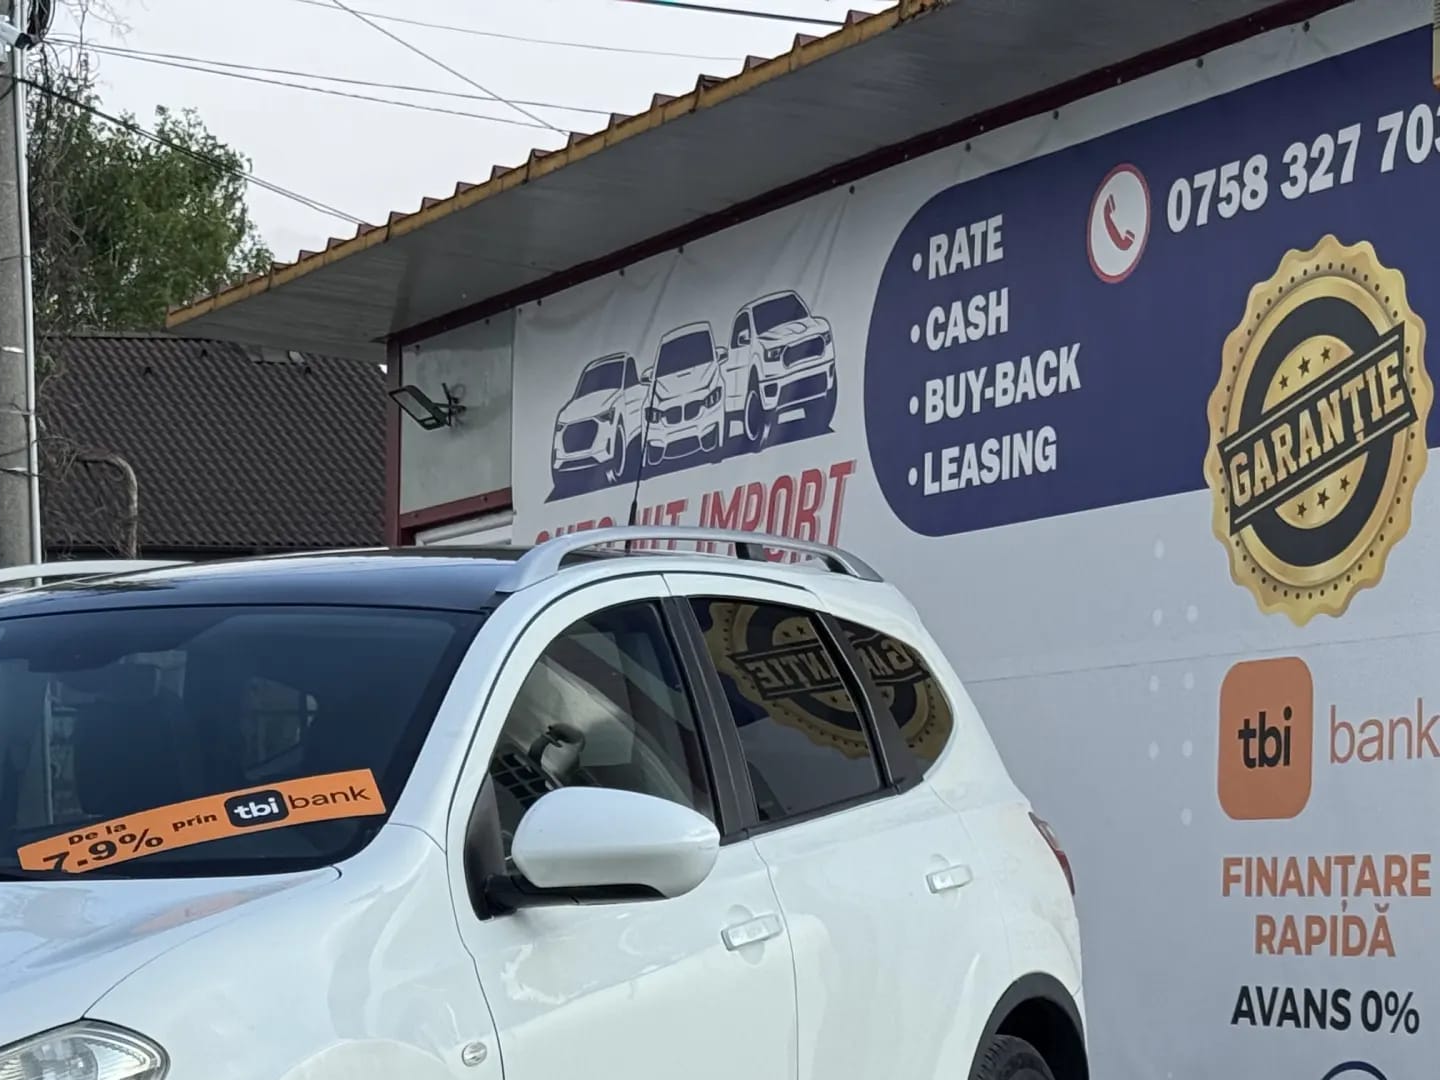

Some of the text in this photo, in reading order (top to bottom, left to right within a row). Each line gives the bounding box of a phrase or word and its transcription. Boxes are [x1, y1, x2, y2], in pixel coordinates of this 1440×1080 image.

[1167, 103, 1440, 233] 0758 327 70
[928, 214, 1004, 280] RATE
[926, 287, 1009, 351] CASH
[925, 343, 1081, 424] BUY-BACK
[924, 425, 1057, 496] LEASING
[1229, 351, 1405, 507] GARANȚIE
[1238, 697, 1440, 769] tbi bank
[68, 823, 127, 846] De la
[172, 813, 218, 832] prin
[234, 797, 280, 819] tbi
[288, 785, 370, 809] bank
[1255, 903, 1396, 957] RAPIDĂ
[1230, 985, 1420, 1034] AVANS 0%
